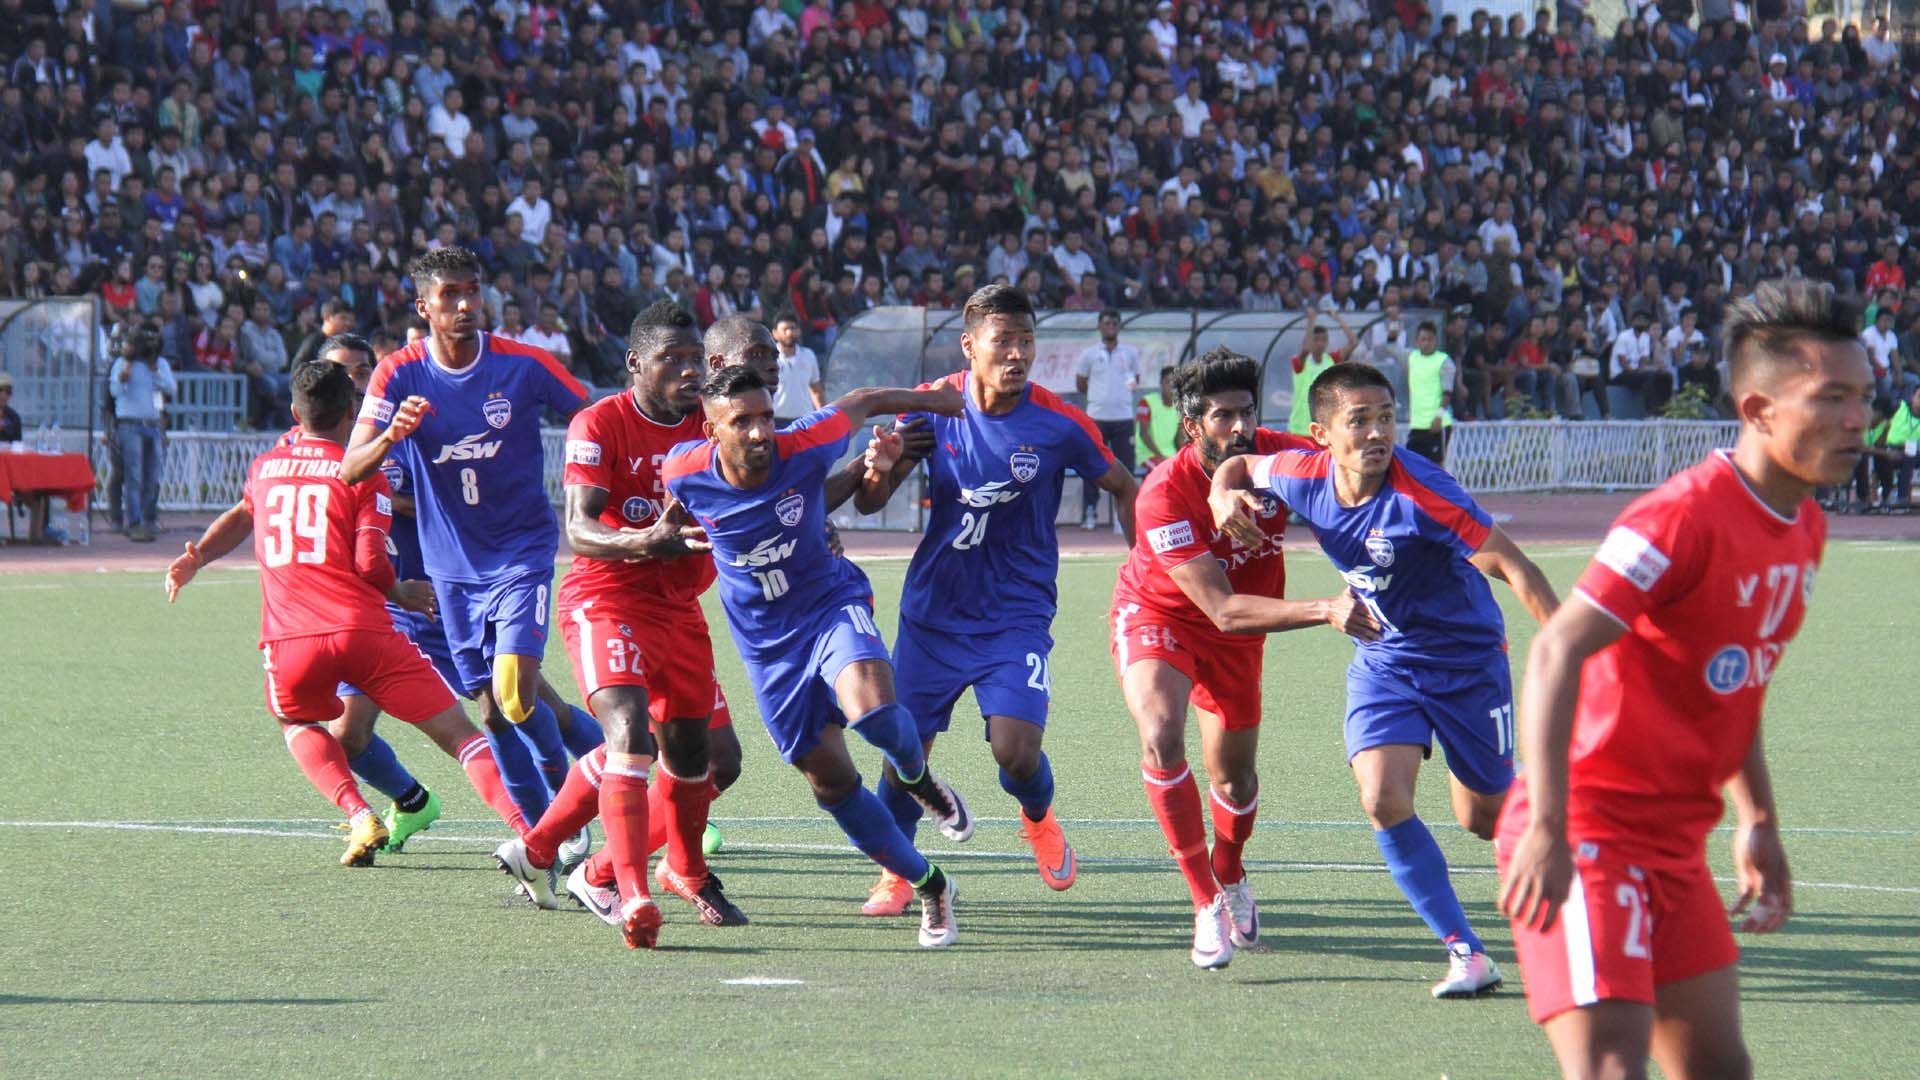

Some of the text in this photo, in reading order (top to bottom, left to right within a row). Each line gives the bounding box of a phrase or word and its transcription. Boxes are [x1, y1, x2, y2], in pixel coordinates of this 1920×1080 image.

[291, 446, 325, 457] RRR
[432, 438, 503, 464] JSW
[460, 468, 480, 505] 8
[263, 484, 330, 568] 39
[952, 511, 990, 550] 24
[728, 538, 798, 568] JSW
[751, 569, 790, 601] 10
[535, 584, 548, 626] 8
[840, 604, 877, 637] 10
[606, 638, 644, 676] 32
[1026, 652, 1053, 697] 24
[1489, 702, 1513, 757] 11
[1615, 882, 1654, 960] 2
